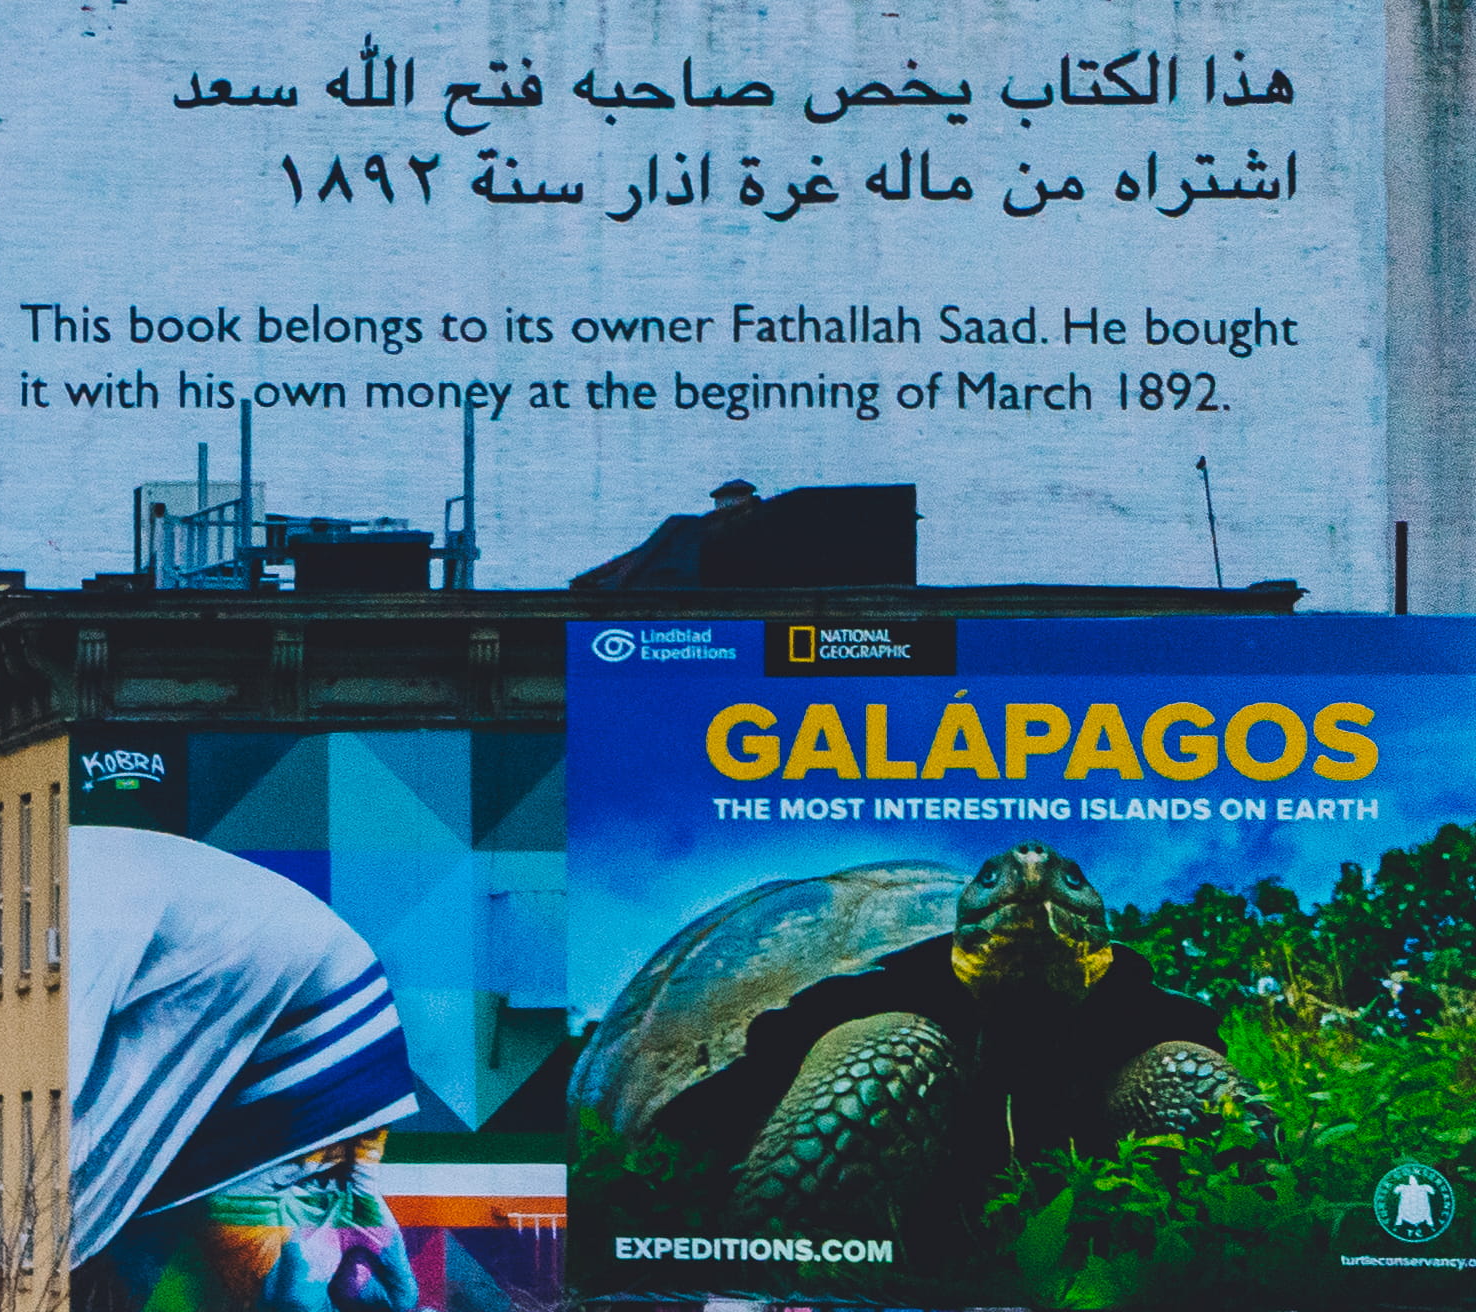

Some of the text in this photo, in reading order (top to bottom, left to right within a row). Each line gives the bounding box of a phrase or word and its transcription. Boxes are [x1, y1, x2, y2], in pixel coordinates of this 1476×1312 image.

[173, 72, 299, 110] سعد
[444, 57, 545, 138] فتح
[573, 56, 776, 128] صاحبه
[804, 59, 974, 127] يخص
[1001, 50, 1179, 130] الكتاب
[1206, 50, 1296, 109] هذا
[281, 148, 1298, 224] اشتراه من ماله غرة اذار سنة ١٨٩٢
[20, 304, 1300, 358] This book belongs to its owner Fathallah Saad. He bought
[21, 370, 1232, 421] it with his own money at the beginning of March 1892.
[640, 628, 713, 644] Lindblad
[640, 645, 737, 663] Expeditions
[819, 645, 912, 660] GEOGRAPHIC
[820, 628, 892, 643] NATIONAL
[706, 689, 1380, 781] GALÁPAGOS
[82, 749, 166, 778] KOBRA
[713, 798, 1380, 821] THE MOST INTERESTING ISLANDS ON EARTH
[614, 1236, 893, 1264] EXPEDITIONS.COM
